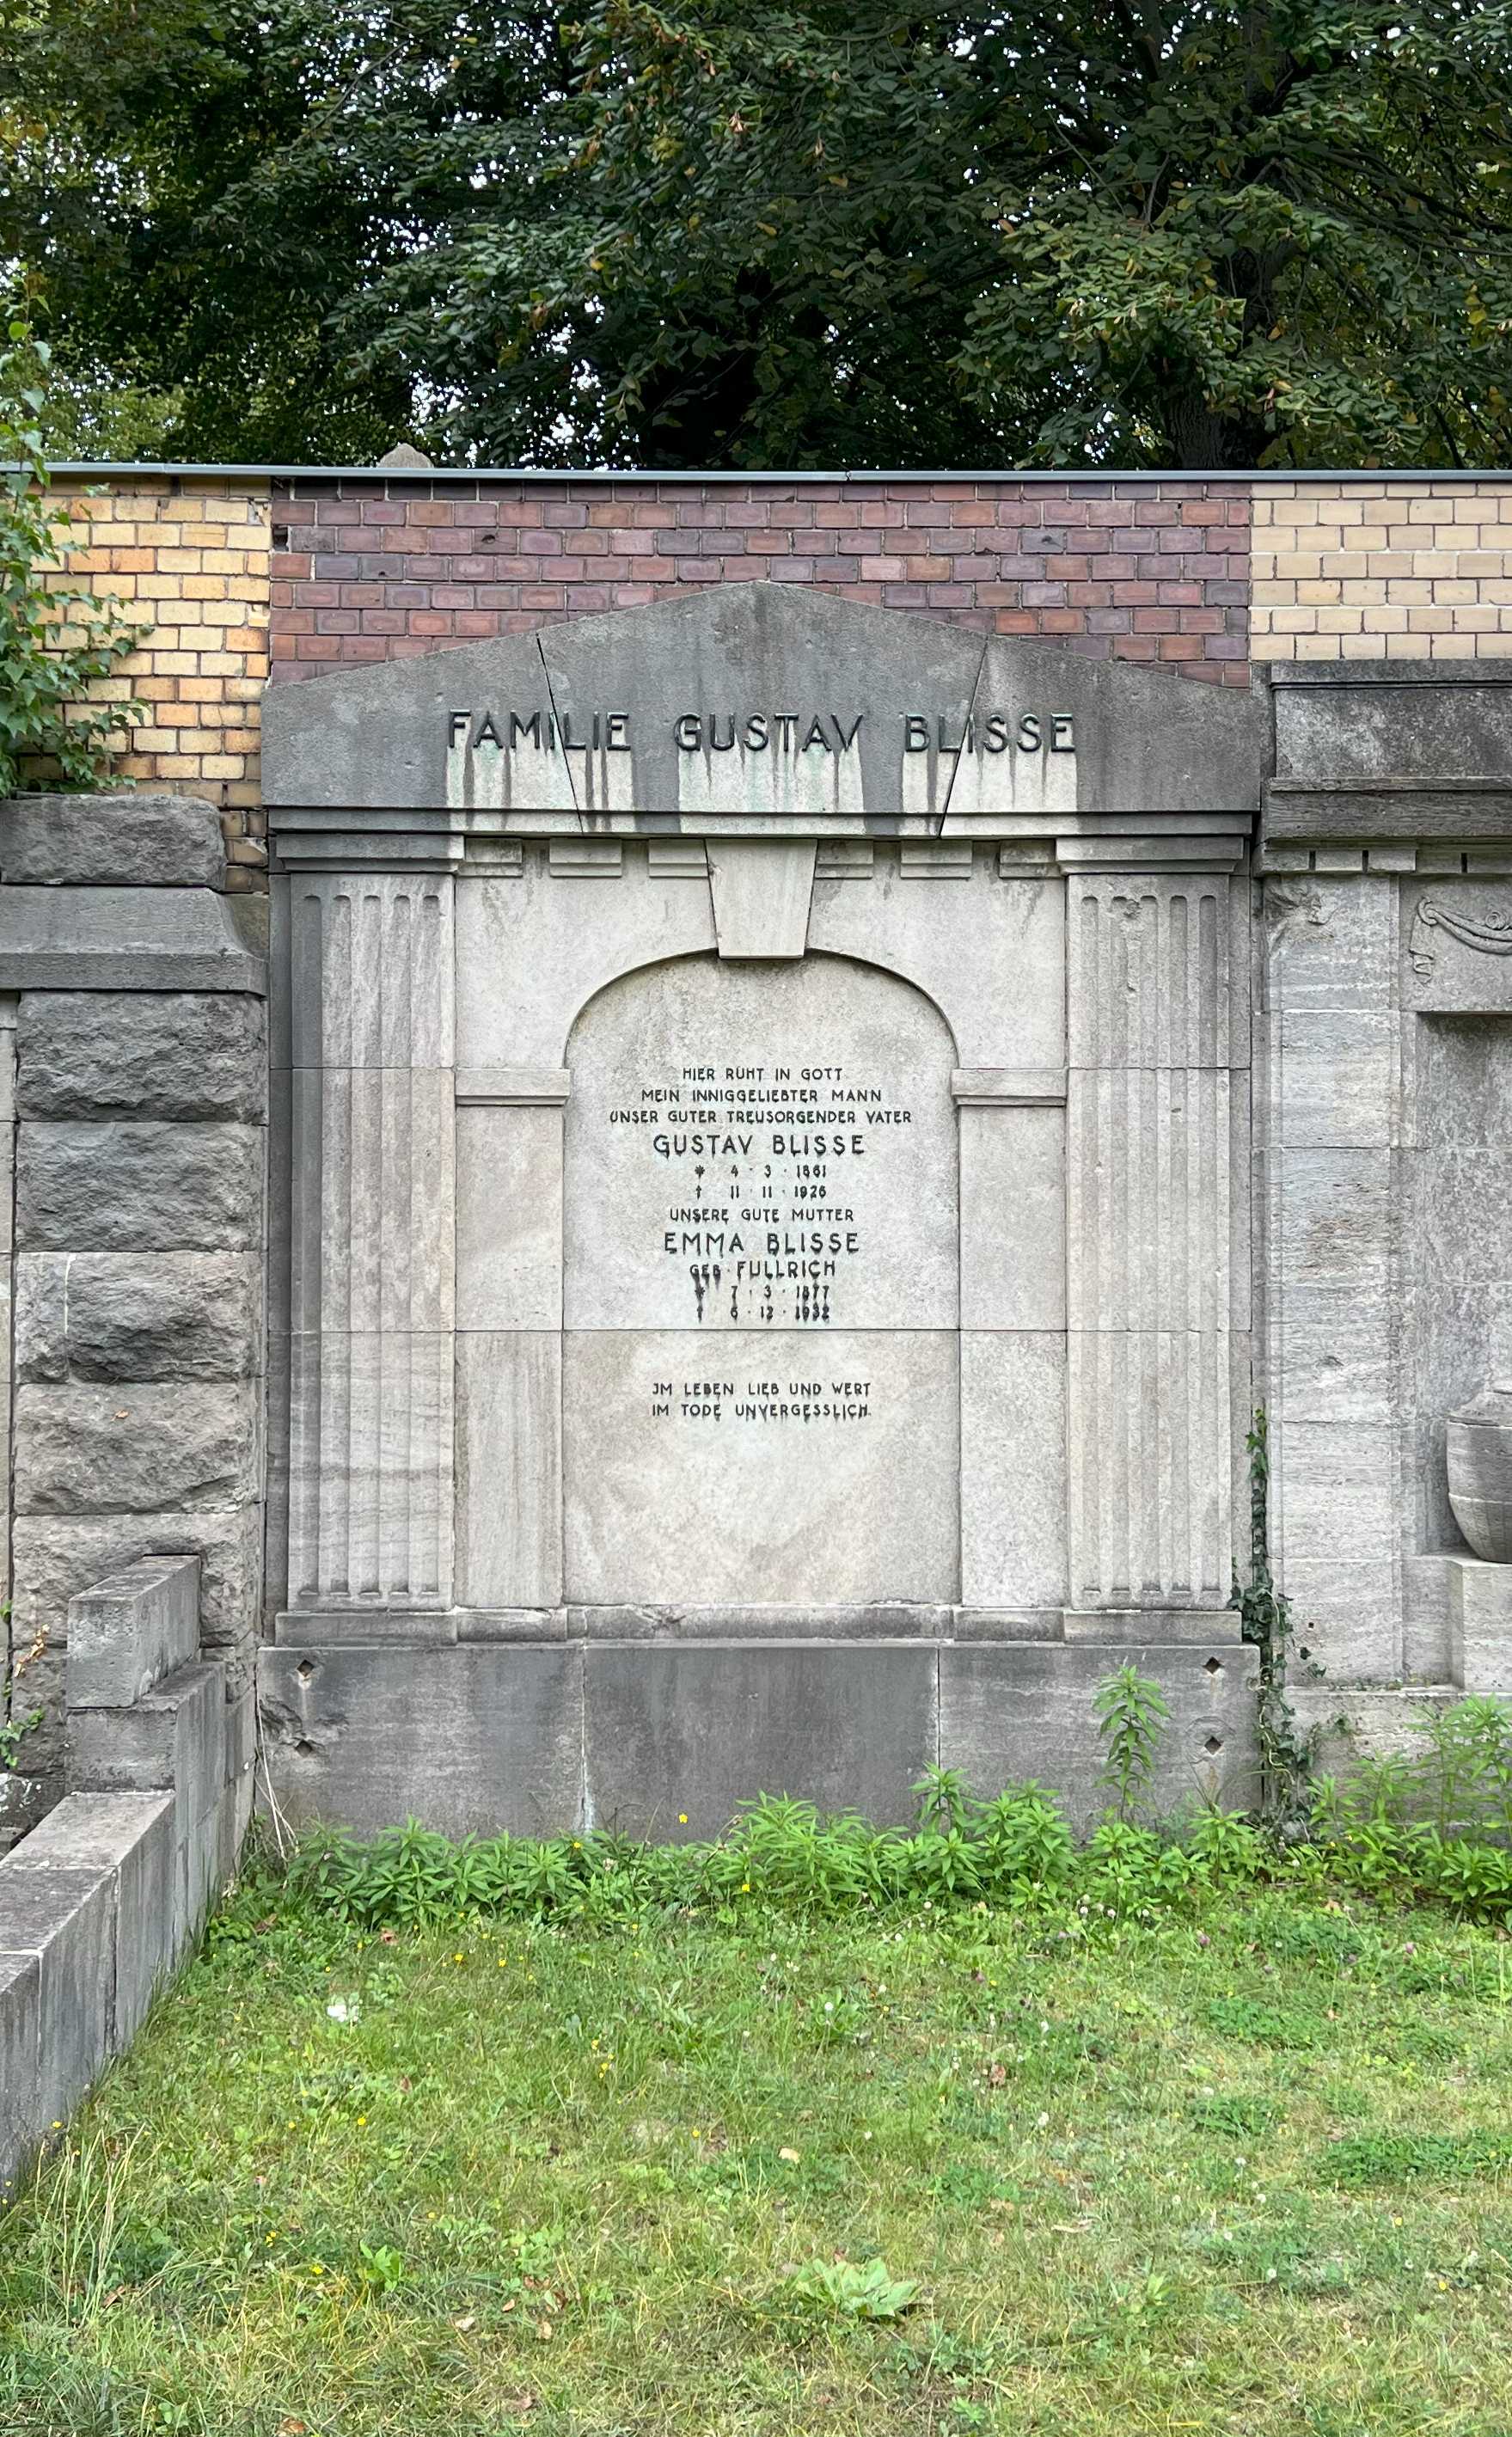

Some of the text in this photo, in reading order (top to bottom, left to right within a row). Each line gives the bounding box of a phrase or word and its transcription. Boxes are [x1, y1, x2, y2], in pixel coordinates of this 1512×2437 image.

[448, 708, 1075, 753] FAMILIE GUSTAV BLISSE
[683, 1067, 843, 1082] HIER RUHT IN GOTT
[641, 1088, 882, 1105] MEIN INNIGGELIEBTER MANN
[609, 1110, 912, 1126] UNSER GUTER TREUSORGENDER VATER
[652, 1134, 866, 1157] GUSTAV BLISSE
[670, 1208, 854, 1224] UNSERE GUTE MUTTER
[664, 1231, 860, 1255] EMMA BLISSE
[737, 1259, 836, 1279] FULLRICH
[683, 1382, 734, 1399] LEBEN
[748, 1382, 780, 1399] LIEB
[789, 1382, 823, 1399] UND
[831, 1381, 872, 1399] WERT
[652, 1404, 670, 1417] IM
[680, 1403, 722, 1419] TODE
